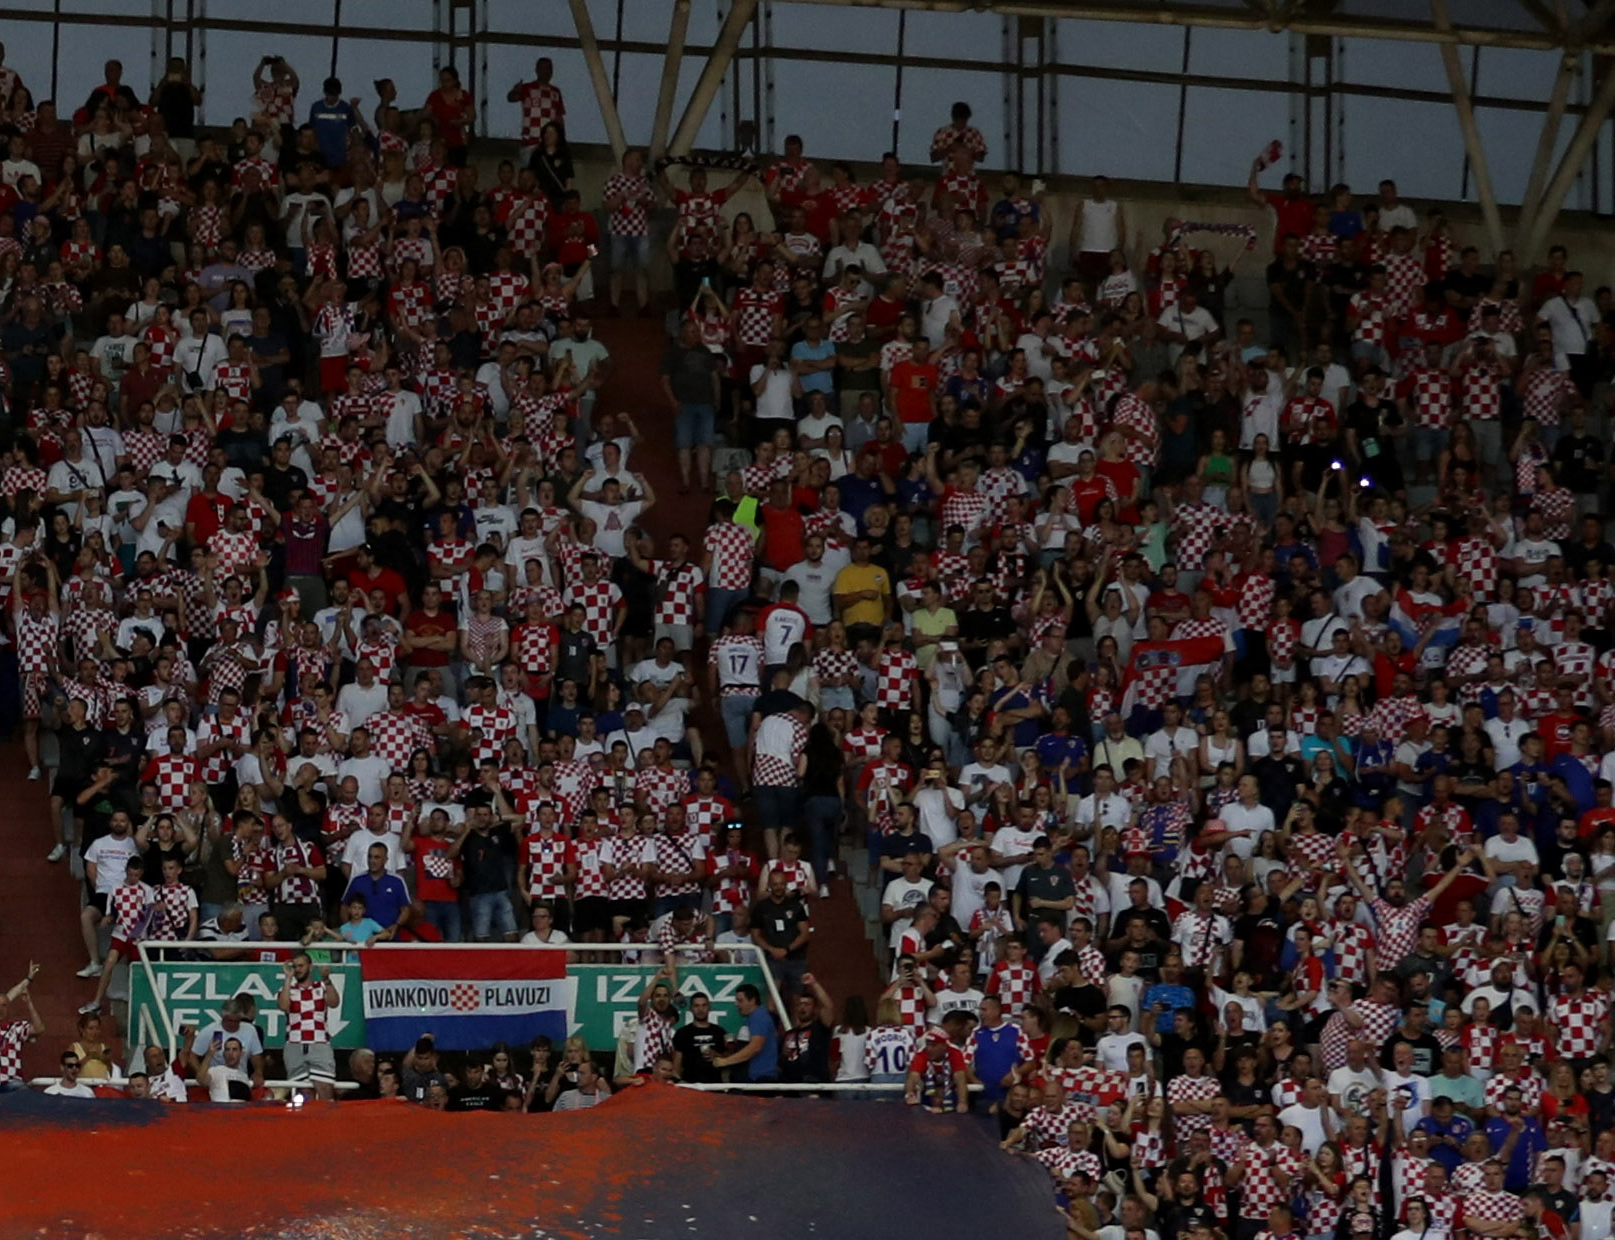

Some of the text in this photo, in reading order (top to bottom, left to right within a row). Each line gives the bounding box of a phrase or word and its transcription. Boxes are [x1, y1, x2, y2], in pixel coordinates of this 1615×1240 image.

[369, 986, 551, 1009] IVANKOVO PLAVUZI
[877, 1045, 906, 1073] 10
